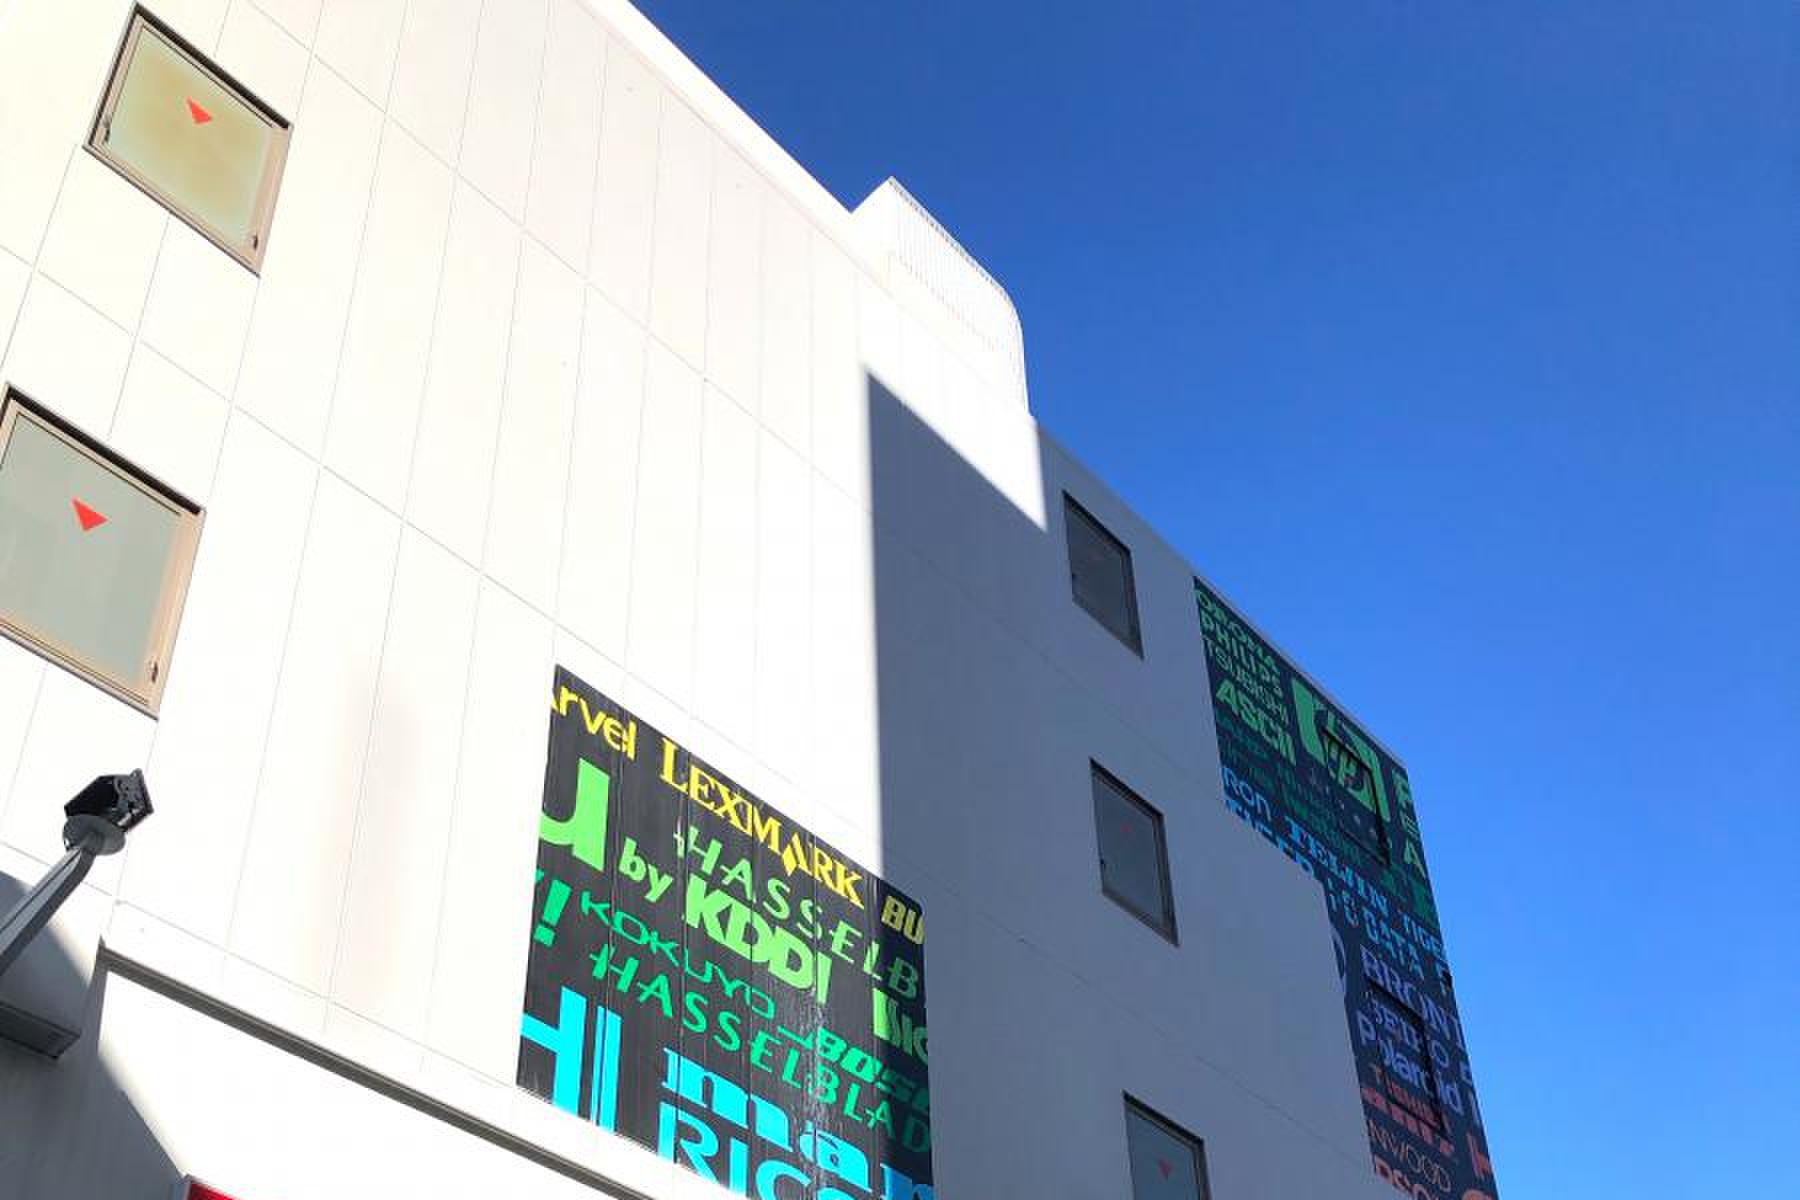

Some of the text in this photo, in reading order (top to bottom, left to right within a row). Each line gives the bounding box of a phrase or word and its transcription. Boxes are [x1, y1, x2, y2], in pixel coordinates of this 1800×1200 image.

[660, 737, 865, 909] LEXMARK
[580, 891, 775, 1020] KOKUYO
[619, 837, 673, 903] by
[684, 873, 833, 1005] KDDI
[590, 943, 931, 1152] HASSELBLAD
